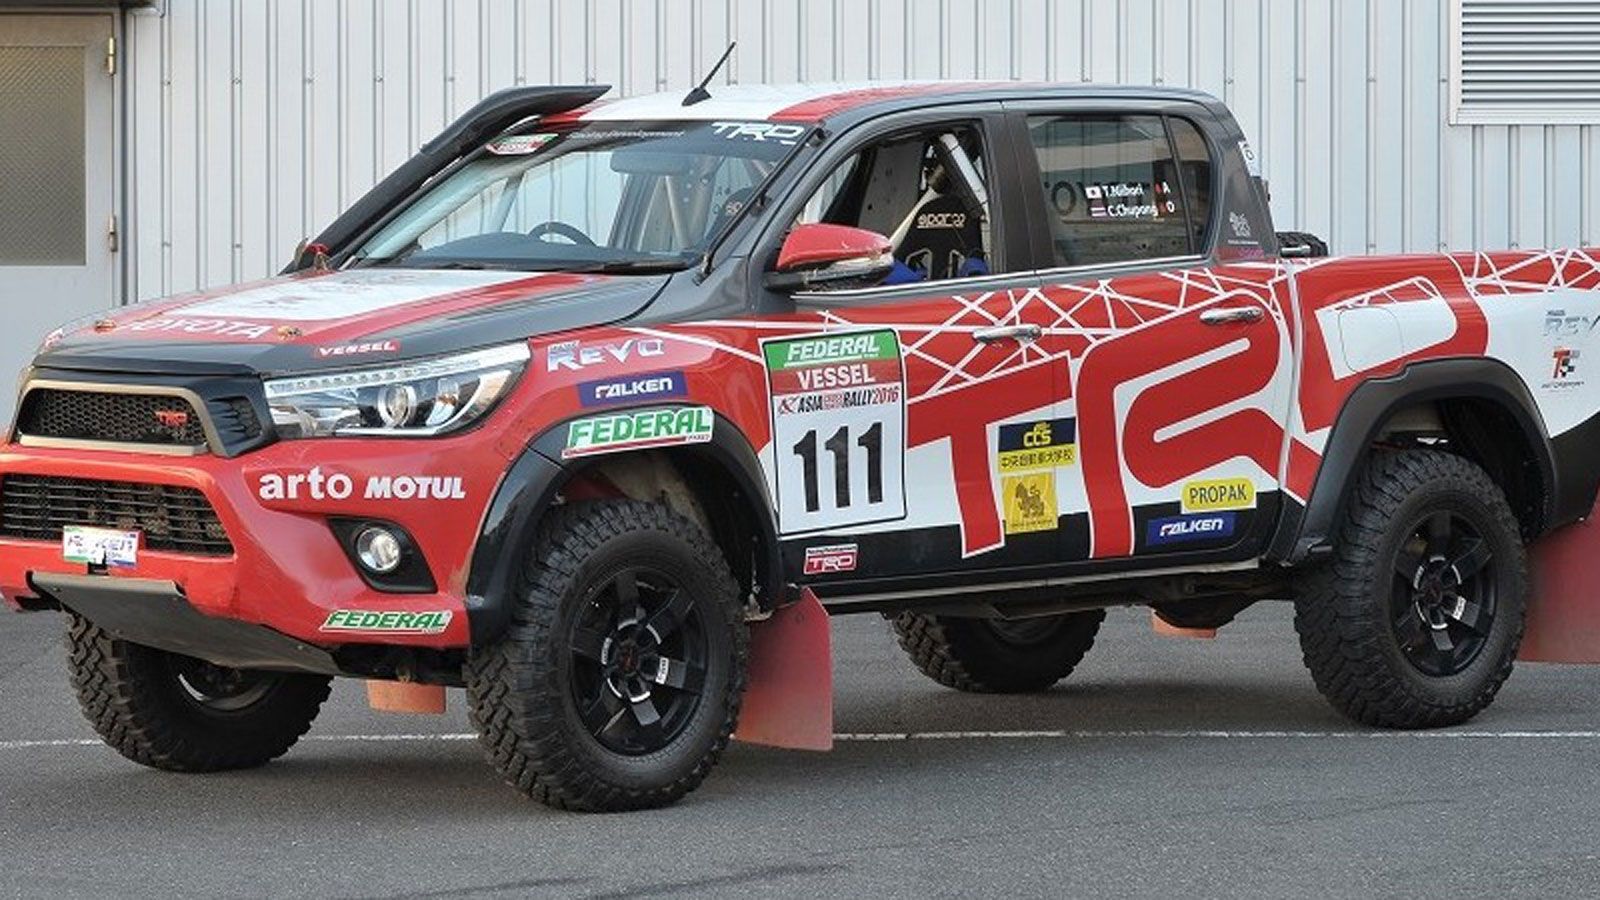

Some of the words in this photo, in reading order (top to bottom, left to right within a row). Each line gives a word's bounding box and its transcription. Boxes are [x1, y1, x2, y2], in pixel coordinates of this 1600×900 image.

[711, 121, 805, 141] TRD
[318, 340, 397, 357] VESSEL
[787, 334, 881, 361] FEDERAL
[595, 376, 674, 399] FALKEN
[796, 363, 877, 391] VESSEL
[568, 406, 712, 448] FEDERAL
[793, 421, 883, 513] 111
[259, 466, 353, 500] arto
[363, 475, 467, 499] MOTUL
[1189, 483, 1247, 505] PROPAK
[1159, 518, 1225, 538] FALKEN
[809, 555, 854, 572] TRD
[327, 611, 448, 629] FEDERAL
